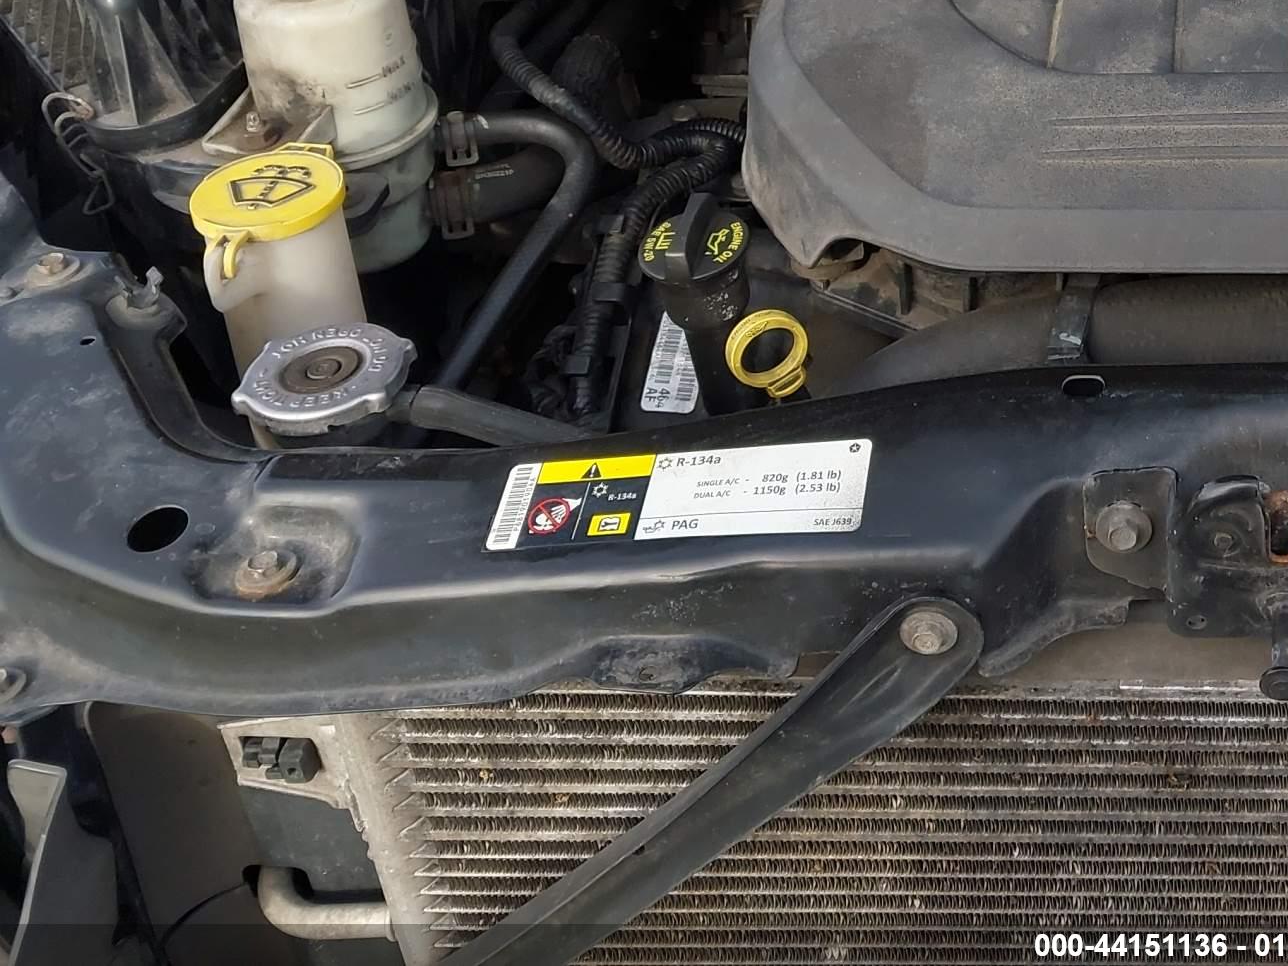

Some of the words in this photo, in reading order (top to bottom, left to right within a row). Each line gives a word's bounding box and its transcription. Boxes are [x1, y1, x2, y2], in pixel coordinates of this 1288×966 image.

[651, 221, 672, 236] SAE
[728, 222, 744, 251] ENGINE
[712, 250, 733, 263] OIL
[290, 387, 349, 408] KEEP
[676, 454, 722, 468] R-134a
[696, 479, 724, 488] SINGLE
[725, 477, 740, 486] A/C
[761, 472, 789, 484] 820g
[796, 470, 824, 483] (1.81
[826, 469, 842, 481] lb)
[608, 492, 637, 502] R-134a
[693, 490, 715, 499] DUAL
[715, 489, 731, 498] A/C
[753, 485, 786, 496] 1150g
[795, 483, 823, 495] (2.53
[825, 482, 841, 494] lb)
[671, 519, 699, 531] PAG
[814, 518, 831, 527] SAE
[831, 517, 852, 527] J639
